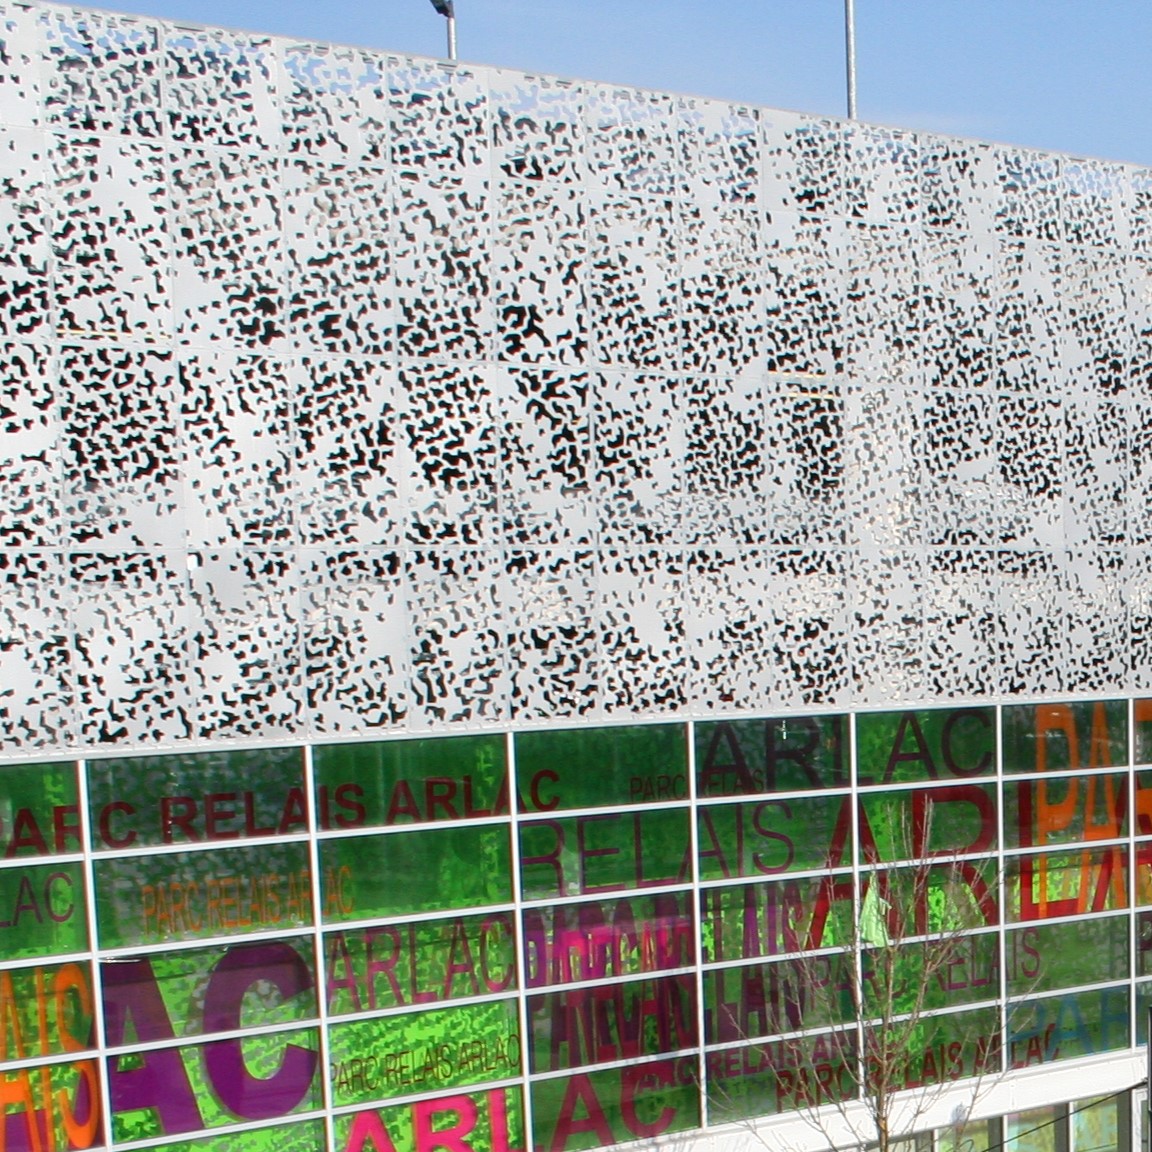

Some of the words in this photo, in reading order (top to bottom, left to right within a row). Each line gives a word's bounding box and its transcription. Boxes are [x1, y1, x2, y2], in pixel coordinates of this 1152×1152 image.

[630, 774, 686, 803] PARC
[699, 707, 994, 795] ARLAC
[0, 799, 137, 859] ARC
[161, 782, 366, 845] RELAIS
[385, 769, 560, 826] ARLAC
[514, 800, 794, 899] RELAIS
[142, 878, 202, 936] PARC
[326, 913, 514, 1013] ARLAC
[330, 1055, 379, 1096] PARC
[384, 1044, 453, 1086] RELAIS
[458, 1033, 521, 1072] ARLAC
